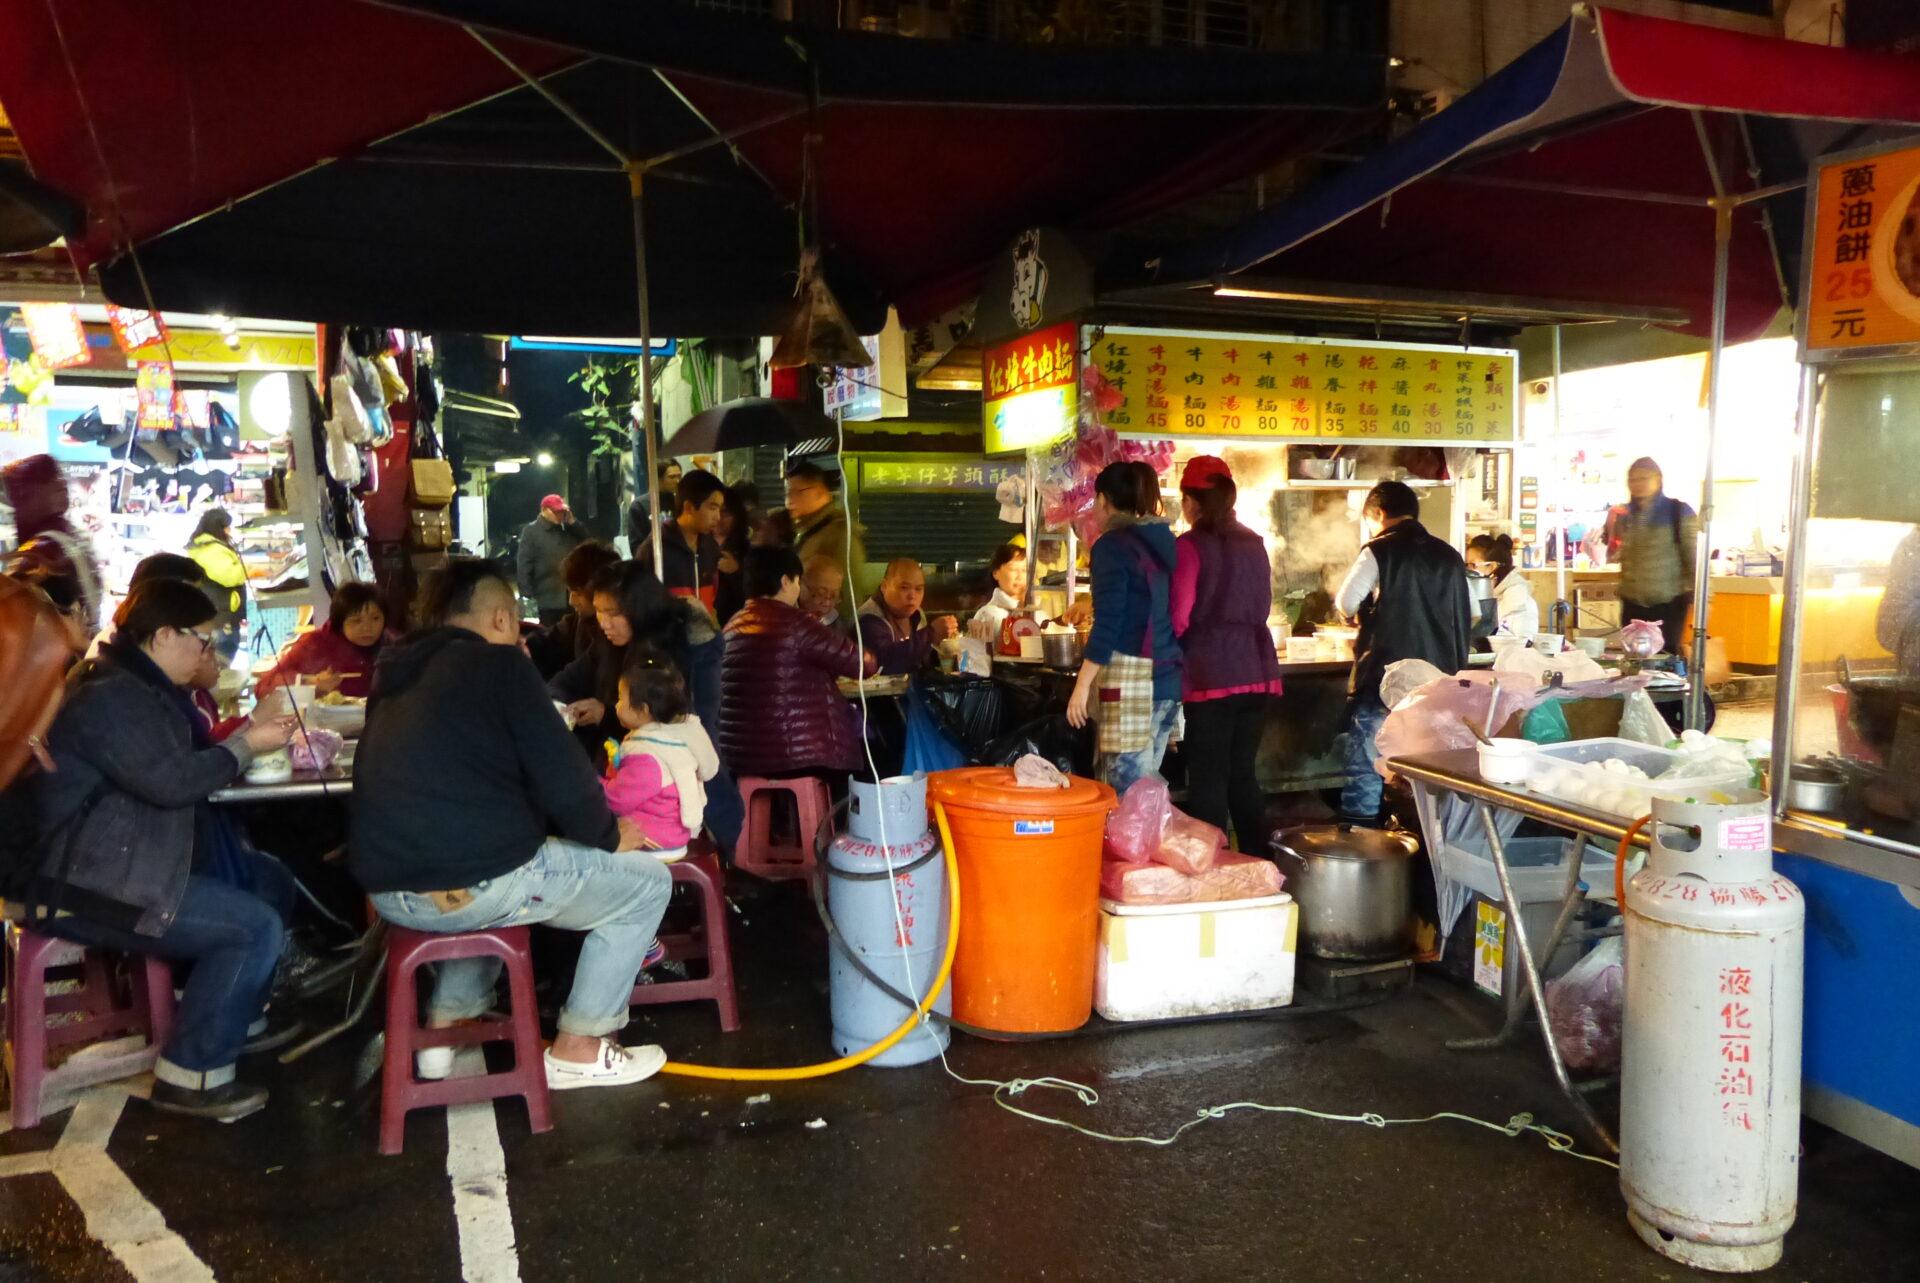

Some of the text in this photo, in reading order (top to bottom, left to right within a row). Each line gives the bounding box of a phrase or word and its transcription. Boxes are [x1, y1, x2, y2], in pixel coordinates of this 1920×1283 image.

[1827, 268, 1873, 302] 25
[1831, 308, 1866, 339] 元
[989, 337, 1073, 396] 紅燒牛肉麵
[1105, 342, 1131, 424] 紅燒牛麵
[1146, 413, 1168, 427] 45
[1185, 413, 1206, 428] 80
[1221, 414, 1241, 429] 70
[1258, 416, 1278, 430] 80
[1290, 417, 1310, 431] 70
[1326, 418, 1345, 432] 35
[1359, 420, 1378, 433] 35
[1392, 420, 1411, 434] 40
[1424, 421, 1442, 435] 30
[1456, 422, 1474, 435] 50
